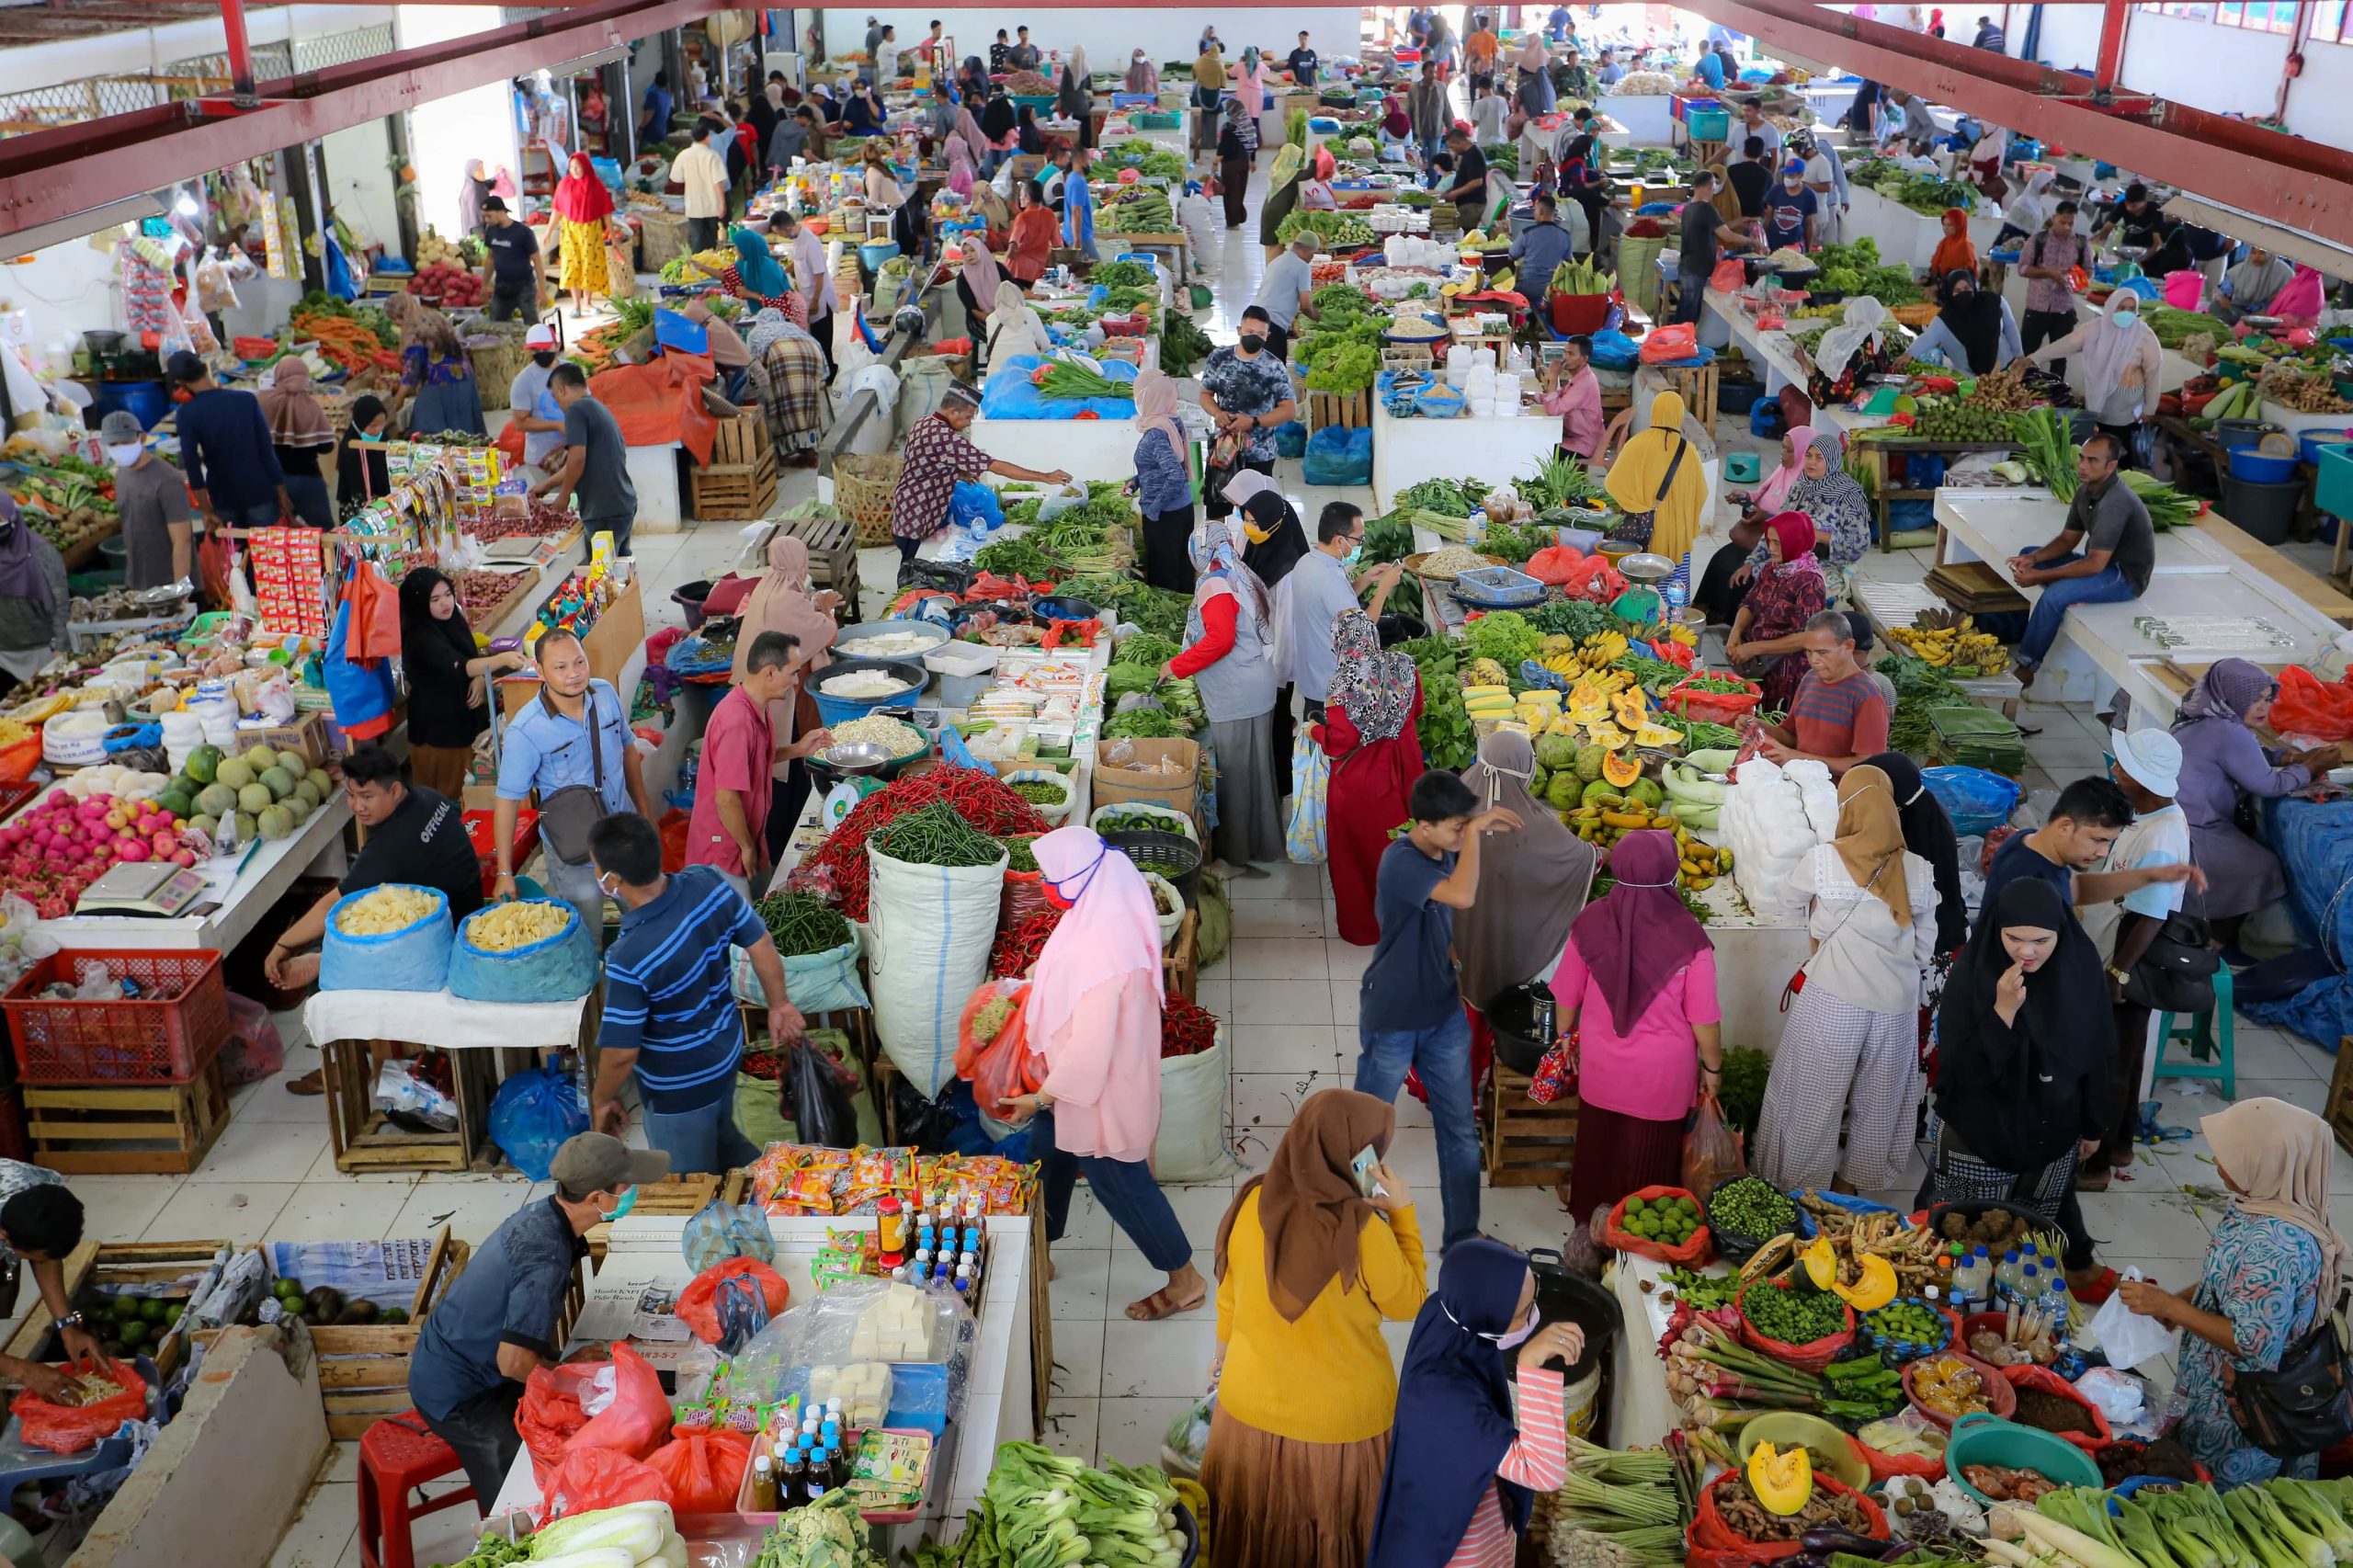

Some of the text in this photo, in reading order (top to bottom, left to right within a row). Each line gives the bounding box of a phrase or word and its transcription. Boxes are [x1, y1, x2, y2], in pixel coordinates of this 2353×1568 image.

[420, 801, 450, 843] OFFICIAL
[726, 1413, 749, 1423] Jelly
[735, 1420, 756, 1430] Jelly
